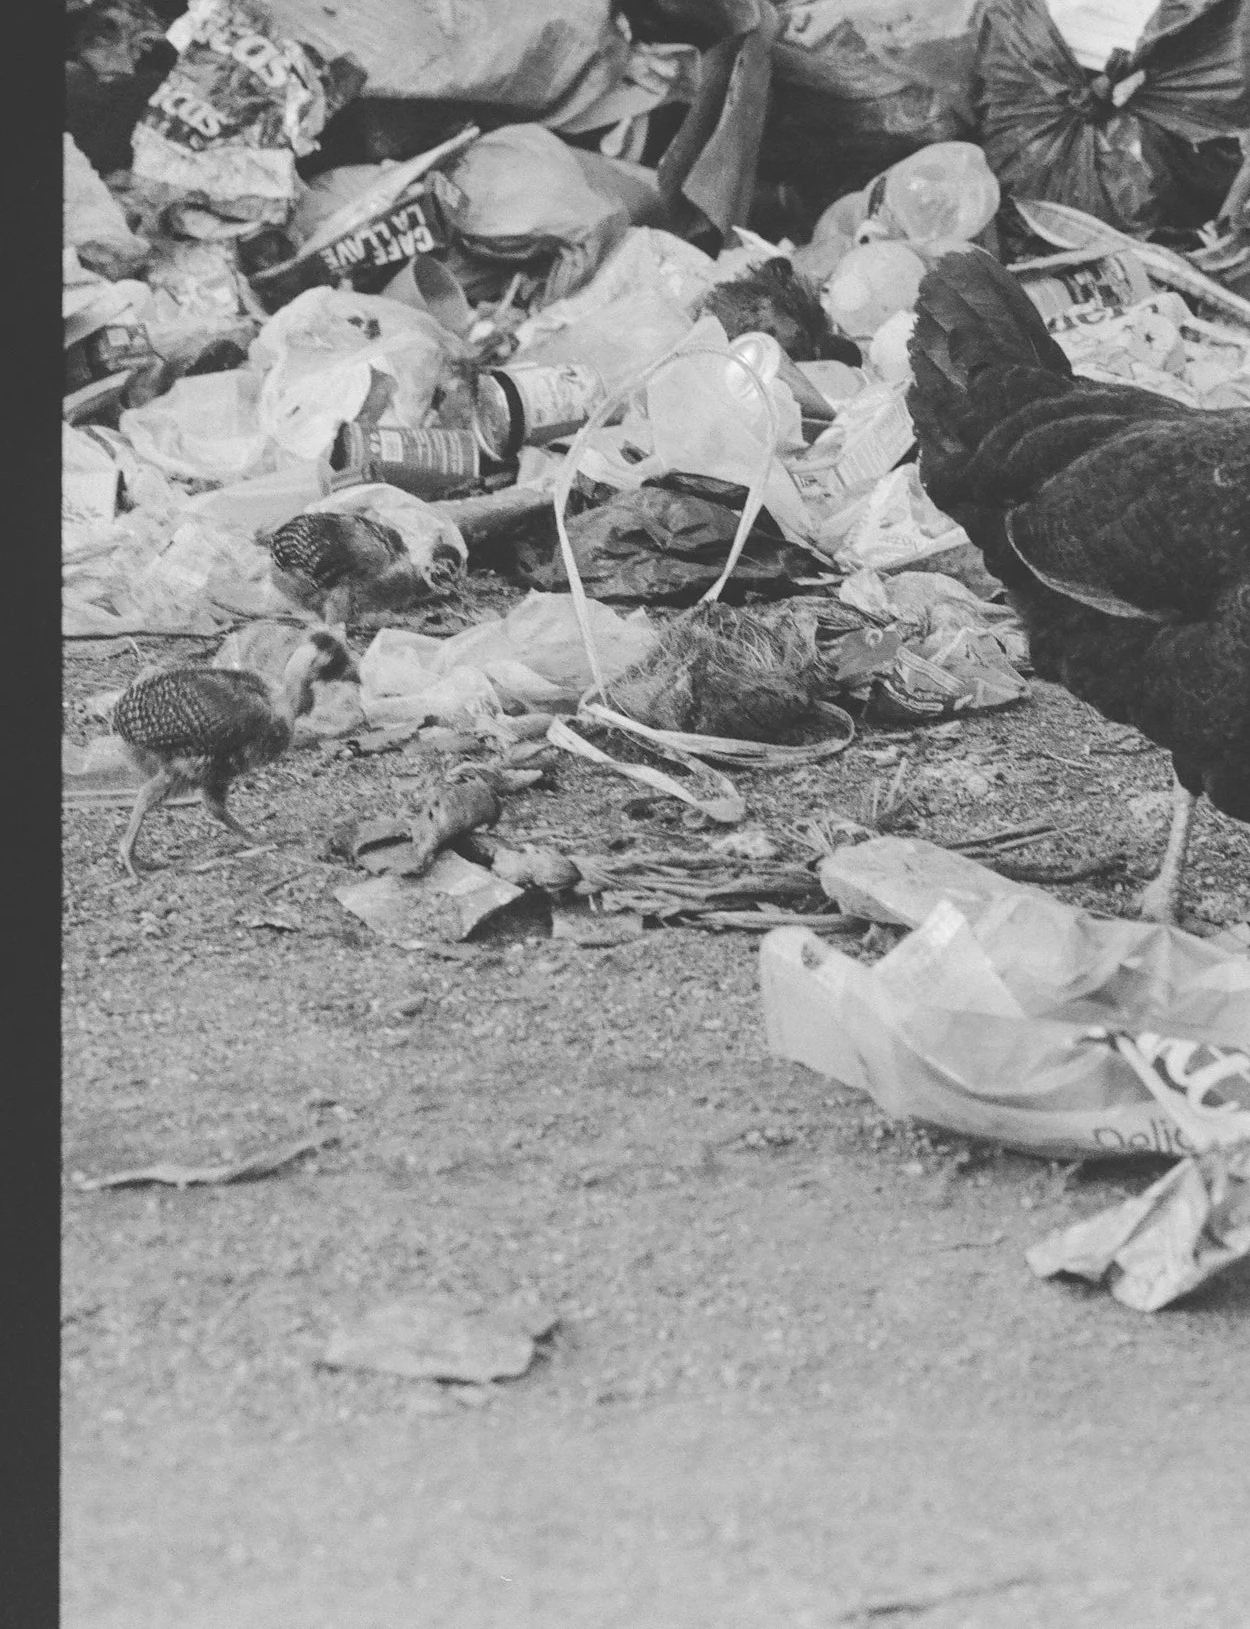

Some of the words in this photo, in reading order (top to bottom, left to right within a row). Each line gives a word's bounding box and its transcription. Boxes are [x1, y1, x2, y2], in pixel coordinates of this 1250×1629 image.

[390, 203, 427, 231] LA
[319, 221, 392, 271] LLAVE
[371, 225, 435, 267] CAFE
